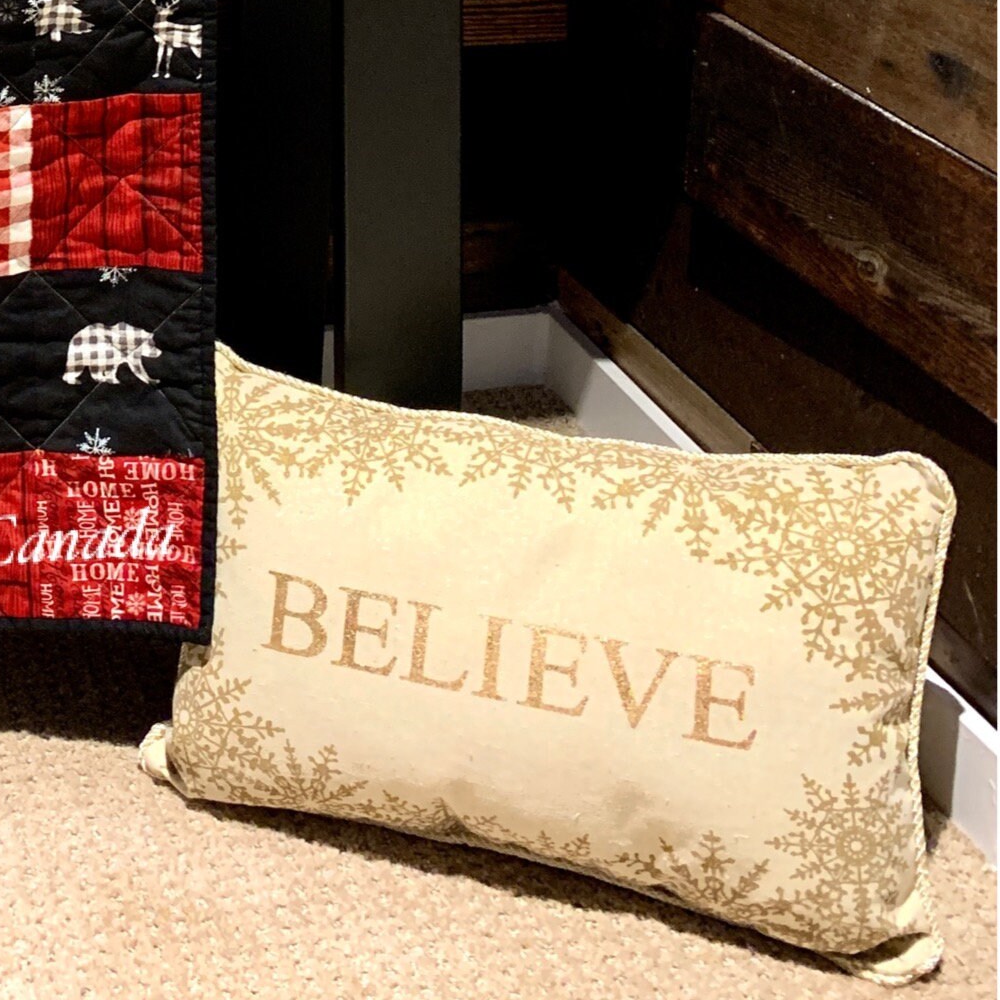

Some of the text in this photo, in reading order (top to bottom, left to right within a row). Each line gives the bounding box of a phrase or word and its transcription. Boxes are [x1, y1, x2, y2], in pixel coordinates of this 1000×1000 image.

[124, 462, 195, 481] HOME
[70, 562, 139, 582] HOME
[261, 570, 758, 751] BELIEVE
